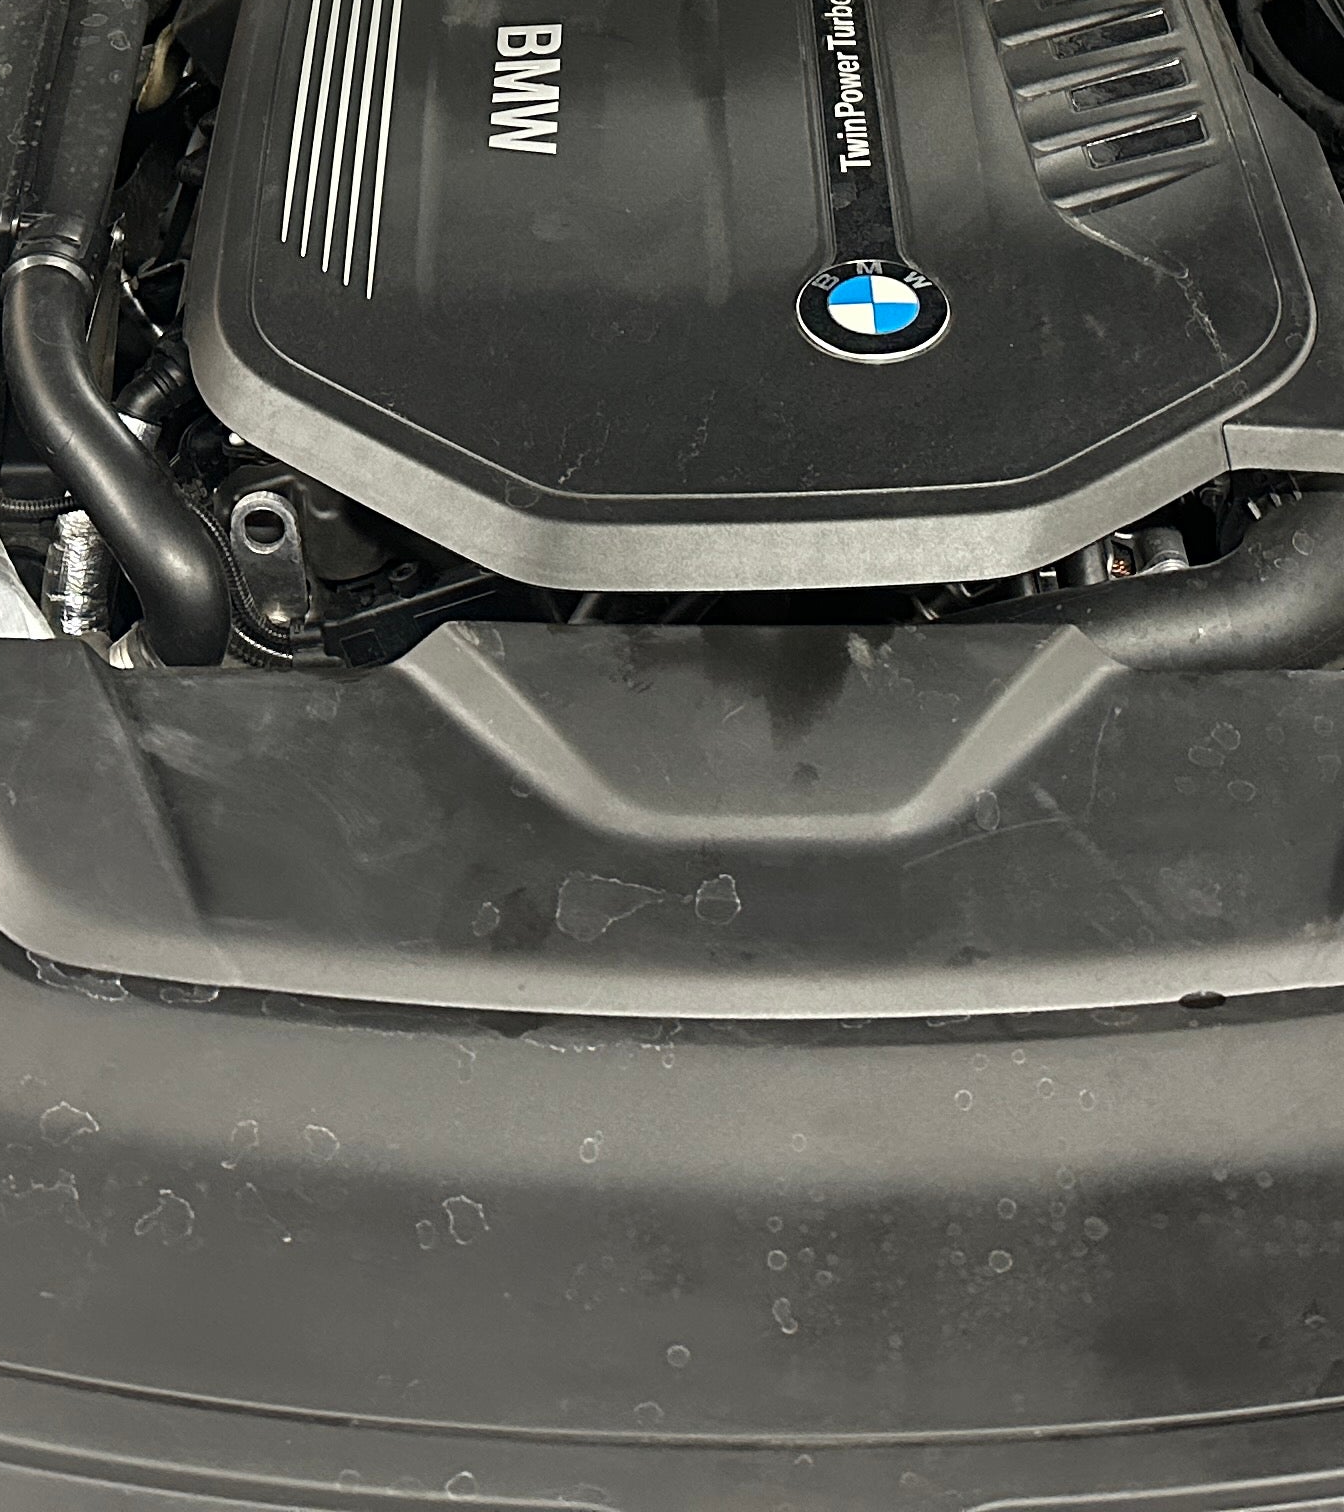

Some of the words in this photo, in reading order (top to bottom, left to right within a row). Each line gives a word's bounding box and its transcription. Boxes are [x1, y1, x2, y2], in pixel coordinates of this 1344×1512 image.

[489, 24, 562, 155] BMW
[834, 51, 872, 173] TwinPower
[812, 261, 933, 291] BMW
